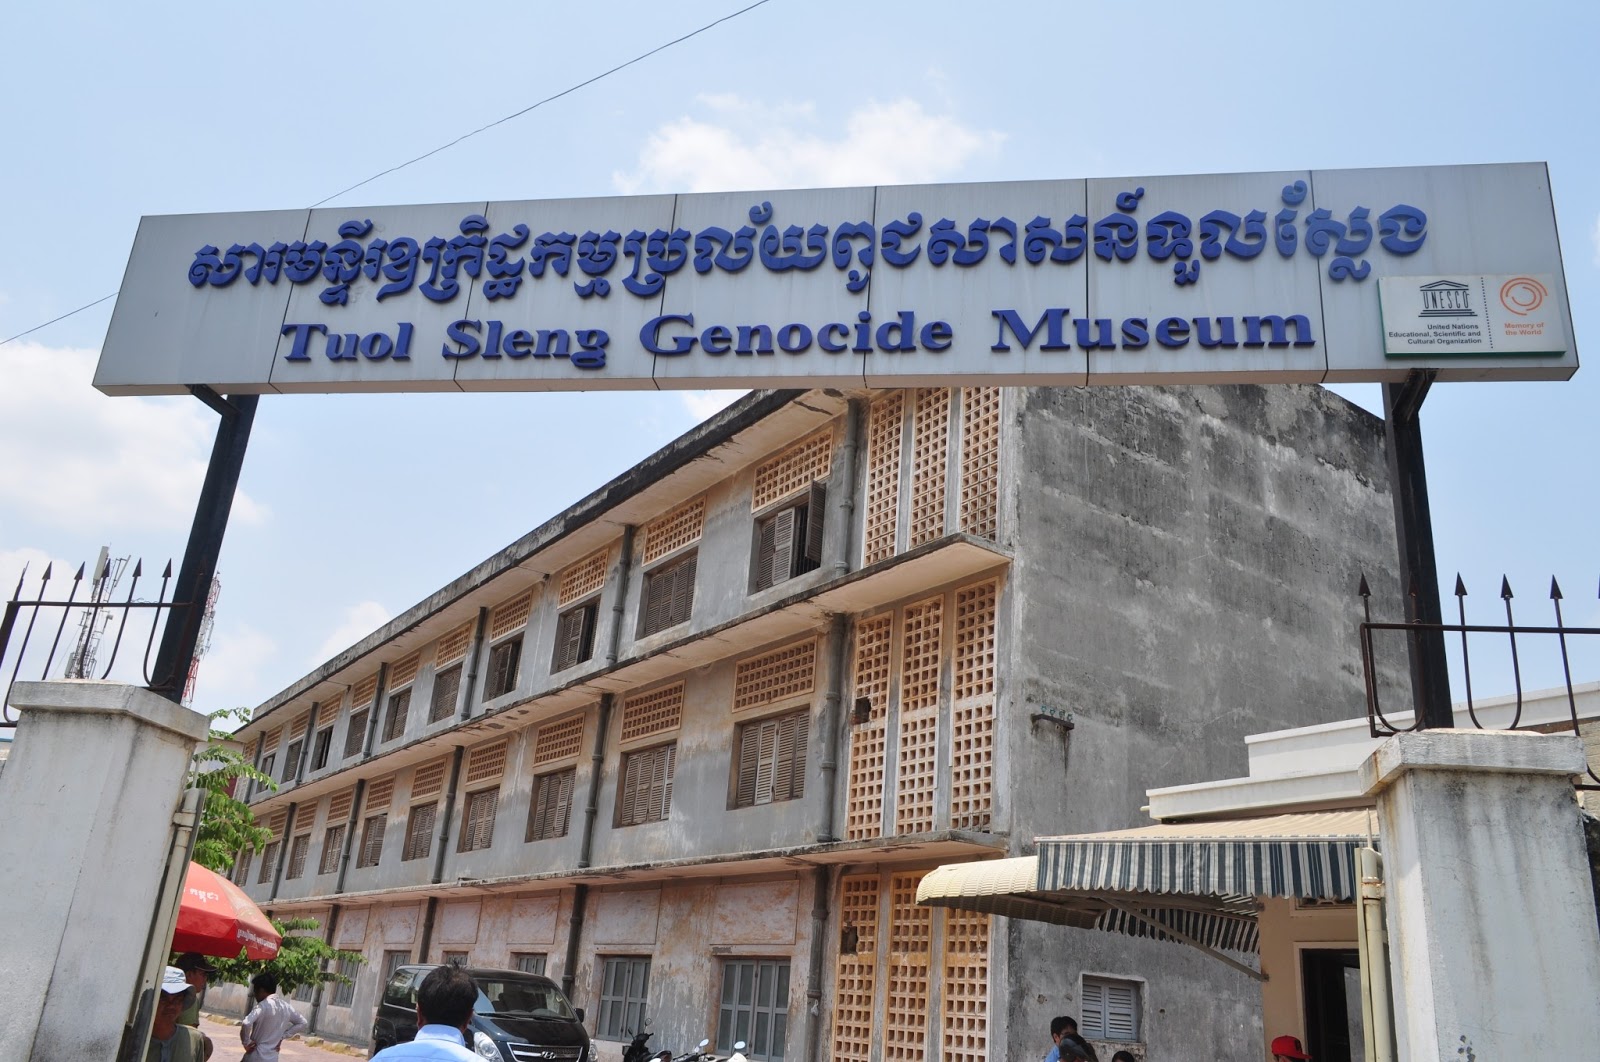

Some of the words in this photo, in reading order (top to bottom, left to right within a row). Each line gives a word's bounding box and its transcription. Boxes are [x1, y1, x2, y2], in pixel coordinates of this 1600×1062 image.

[1422, 290, 1470, 309] UNESCO
[1504, 322, 1535, 330] Memory
[281, 321, 414, 361] Tuol
[441, 318, 610, 369] Sleng
[639, 309, 954, 356] Genocide
[991, 306, 1315, 351] Museum
[1436, 338, 1482, 346] Organization
